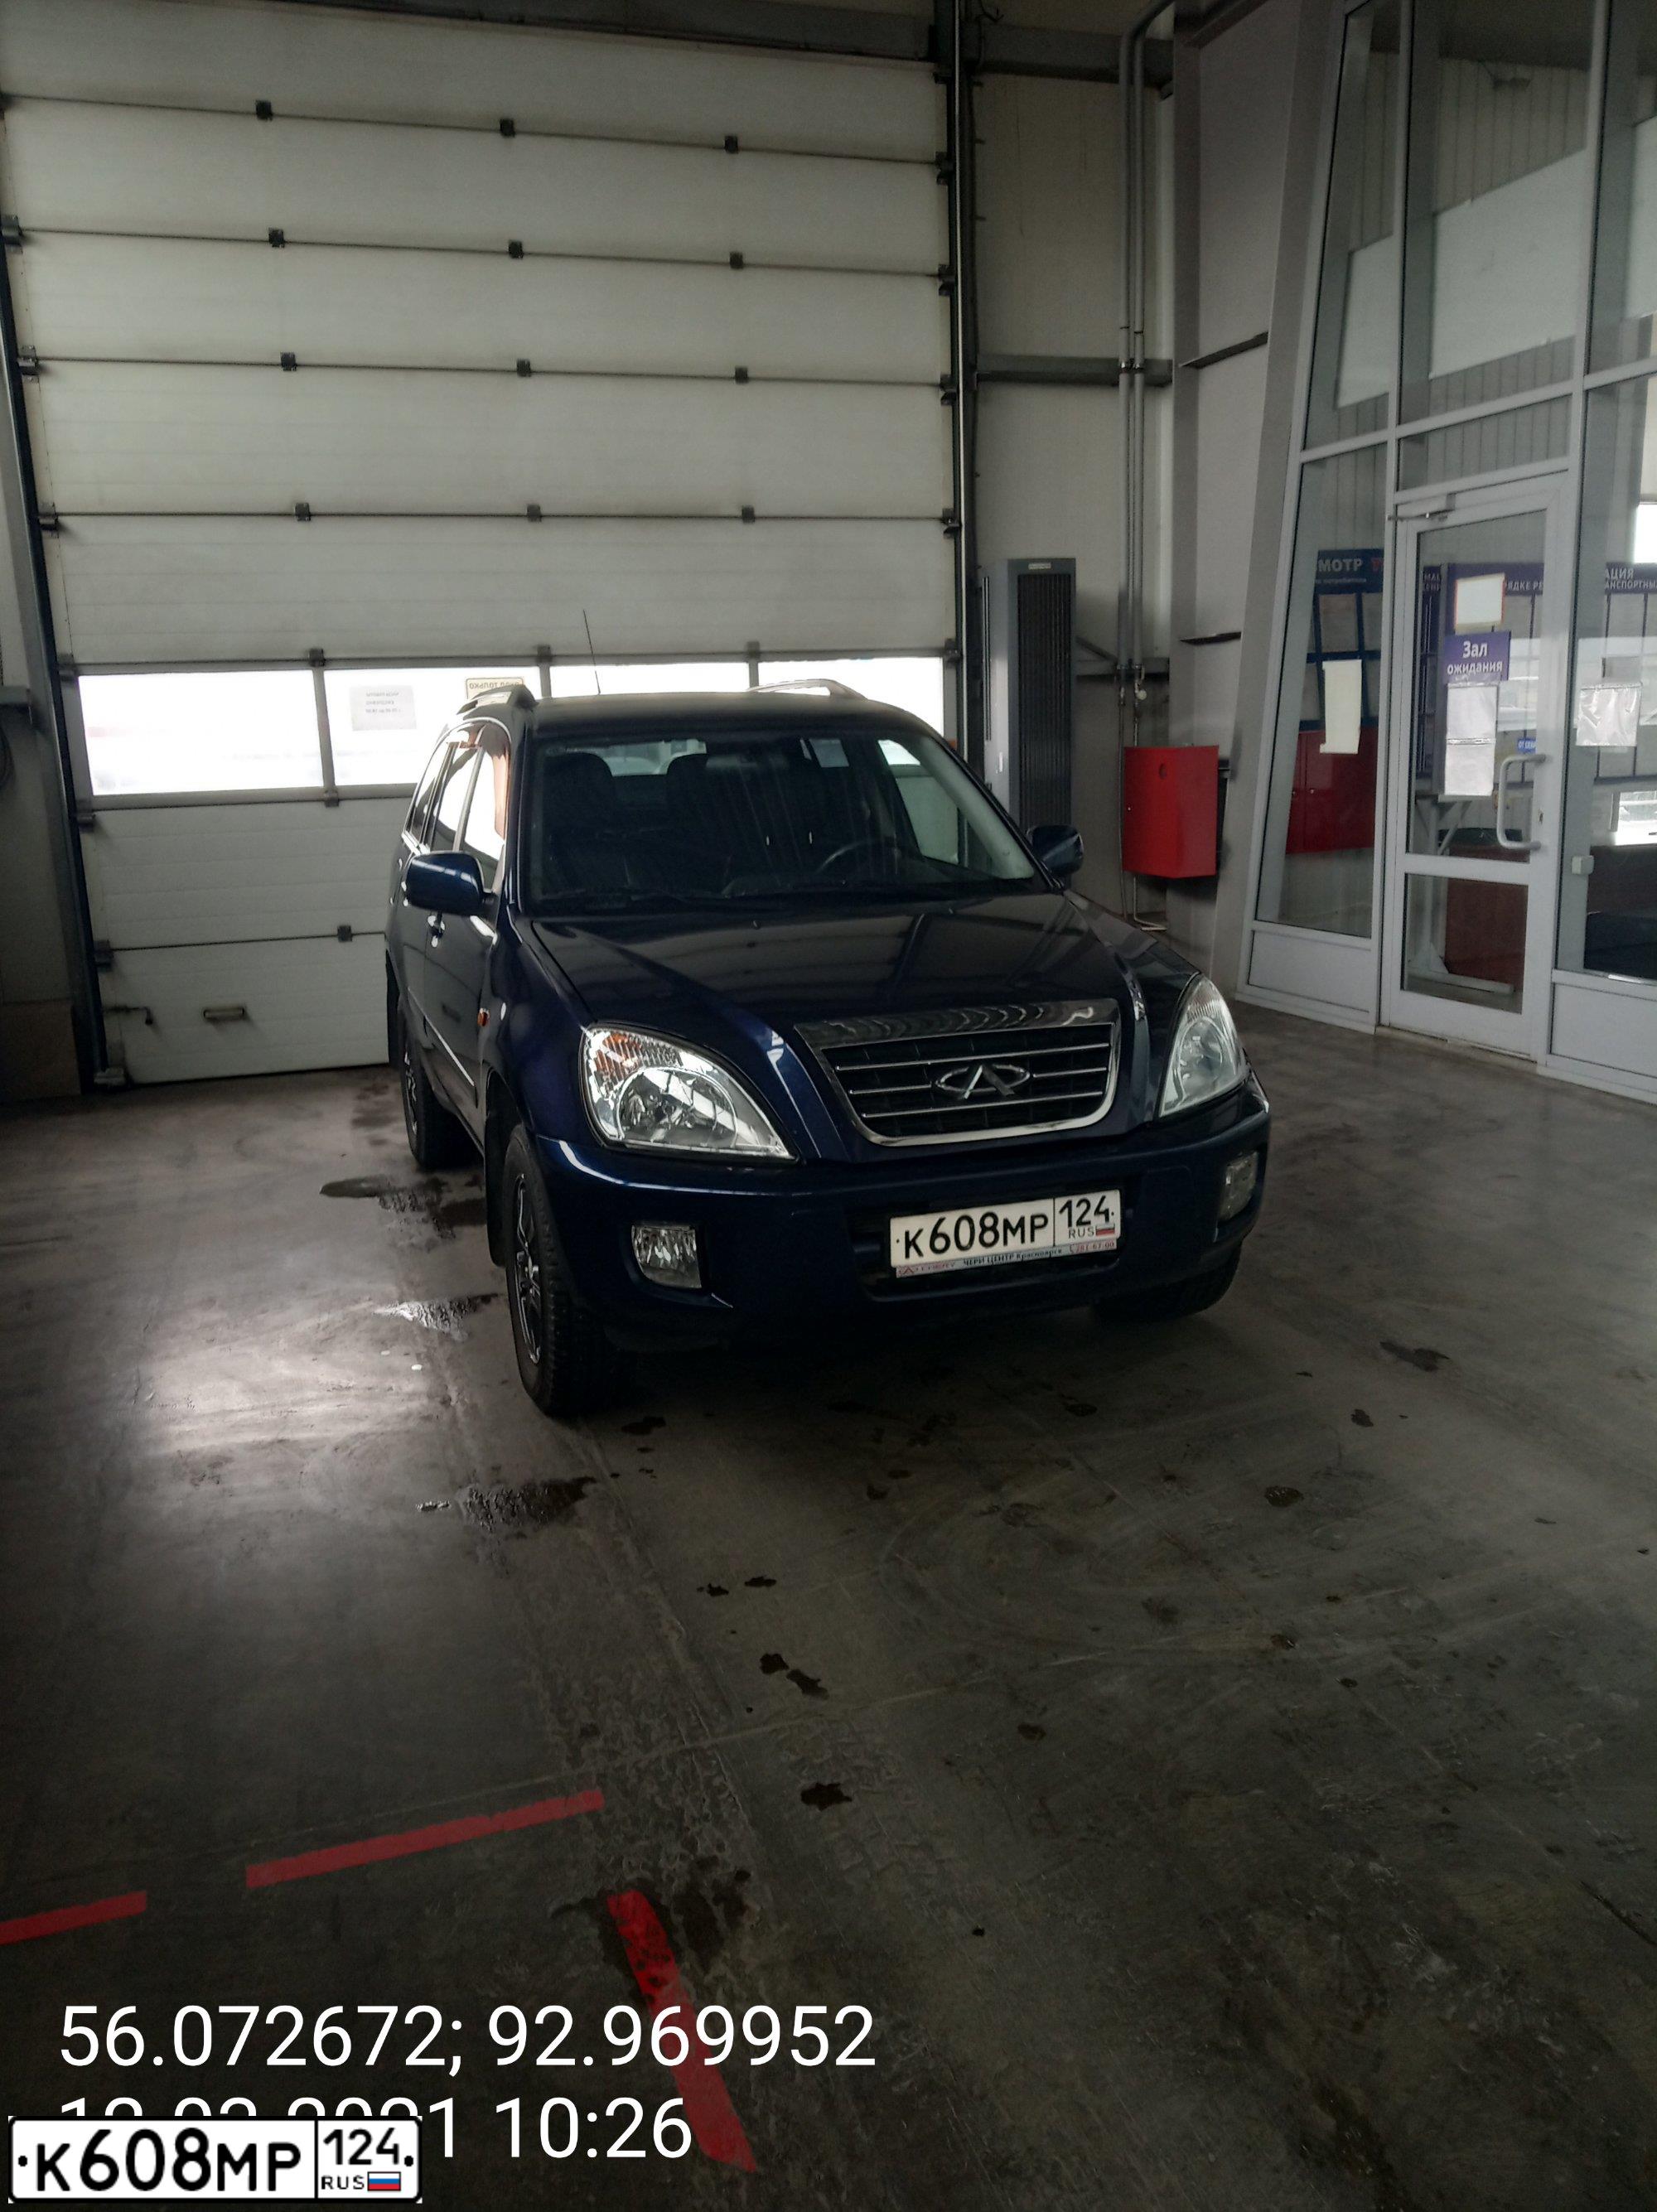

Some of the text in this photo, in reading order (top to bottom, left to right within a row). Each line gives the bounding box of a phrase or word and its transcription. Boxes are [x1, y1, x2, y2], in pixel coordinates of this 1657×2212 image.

[1462, 640, 1488, 659] Зал
[1447, 660, 1503, 676] ожидания
[904, 1195, 1110, 1259] К608МР 124
[1068, 1224, 1095, 1239] RUS
